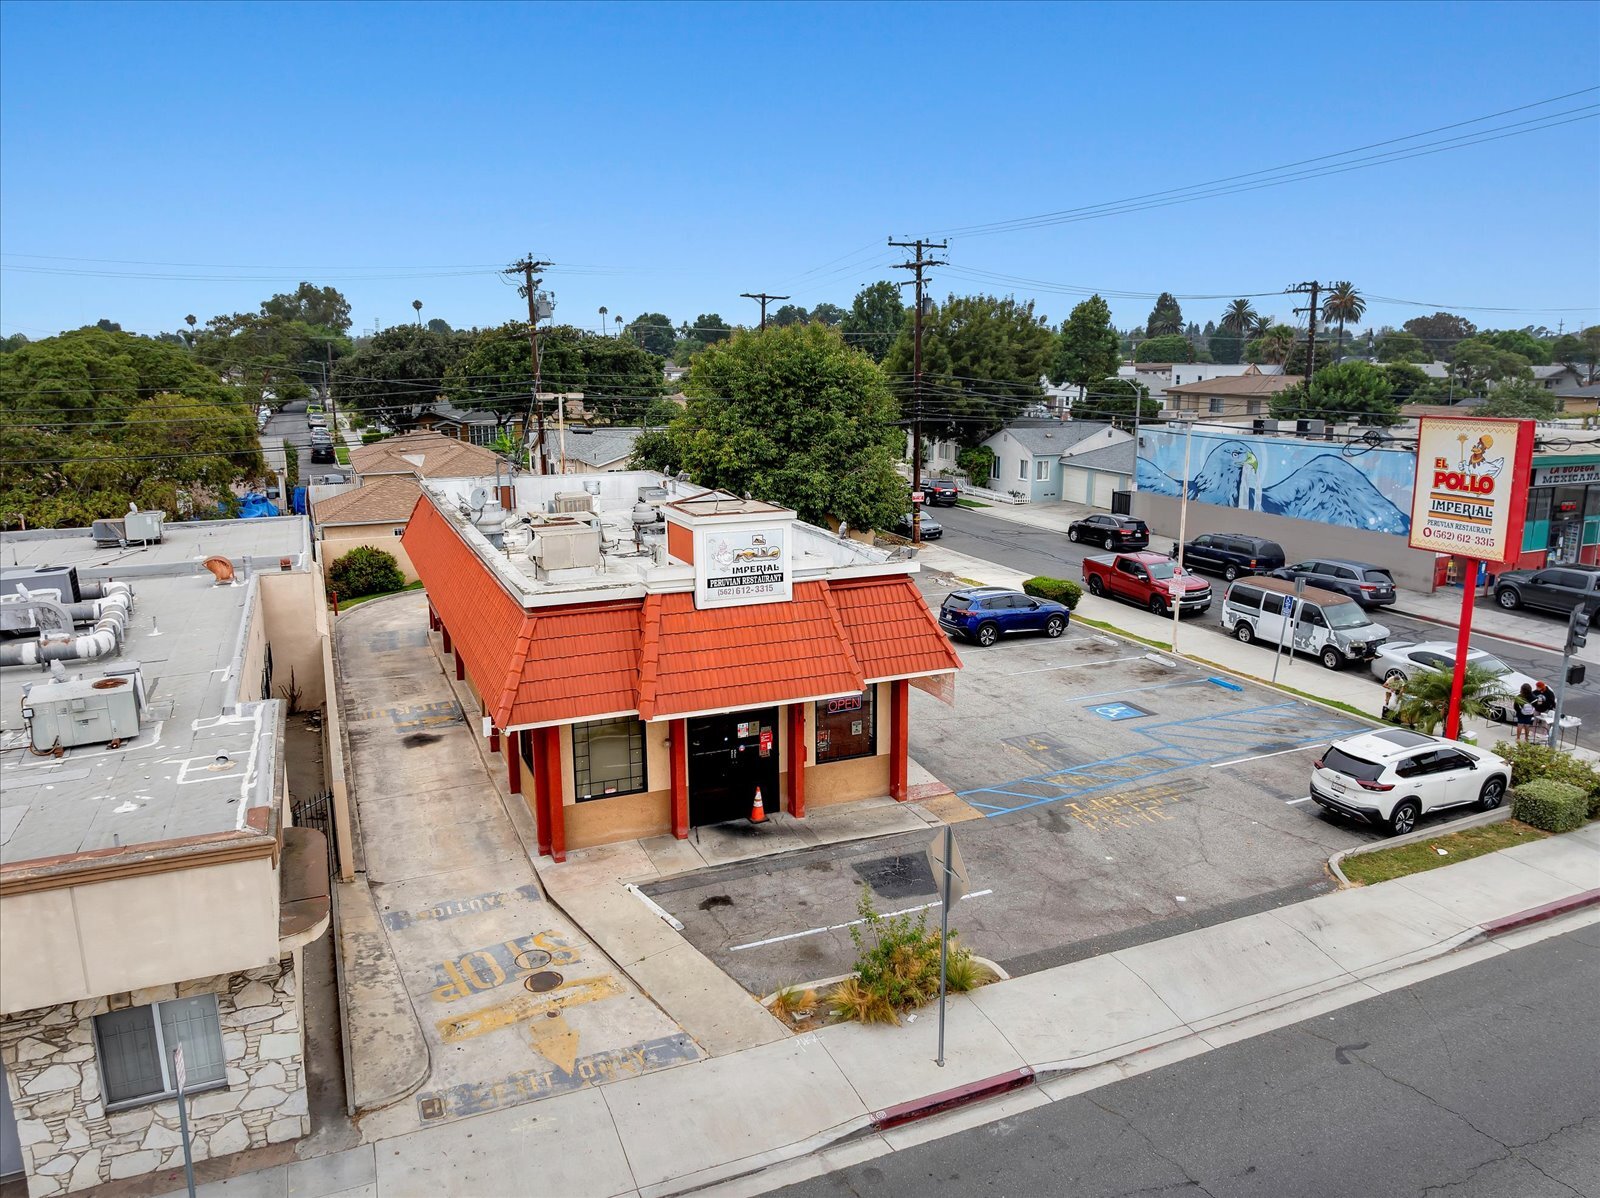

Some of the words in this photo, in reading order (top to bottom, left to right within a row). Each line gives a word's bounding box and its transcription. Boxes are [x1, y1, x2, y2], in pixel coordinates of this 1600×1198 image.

[1435, 457, 1448, 470] EL
[1562, 465, 1595, 474] BODEGA
[1432, 471, 1495, 495] POLLO
[1542, 473, 1600, 484] MEXICANA
[1432, 500, 1493, 519] IMPERIAL
[1427, 519, 1454, 529] PERUVIAN
[1455, 523, 1492, 535] RESTAURANT
[1433, 529, 1455, 541] (562)
[732, 564, 779, 575] IMPERIAL
[710, 577, 741, 588] PERUVIAN
[742, 574, 782, 585] RESTAURANT
[718, 588, 734, 596] (562)
[736, 584, 774, 594] 612-3315
[829, 697, 860, 711] OPEN
[431, 929, 581, 1002] STOP
